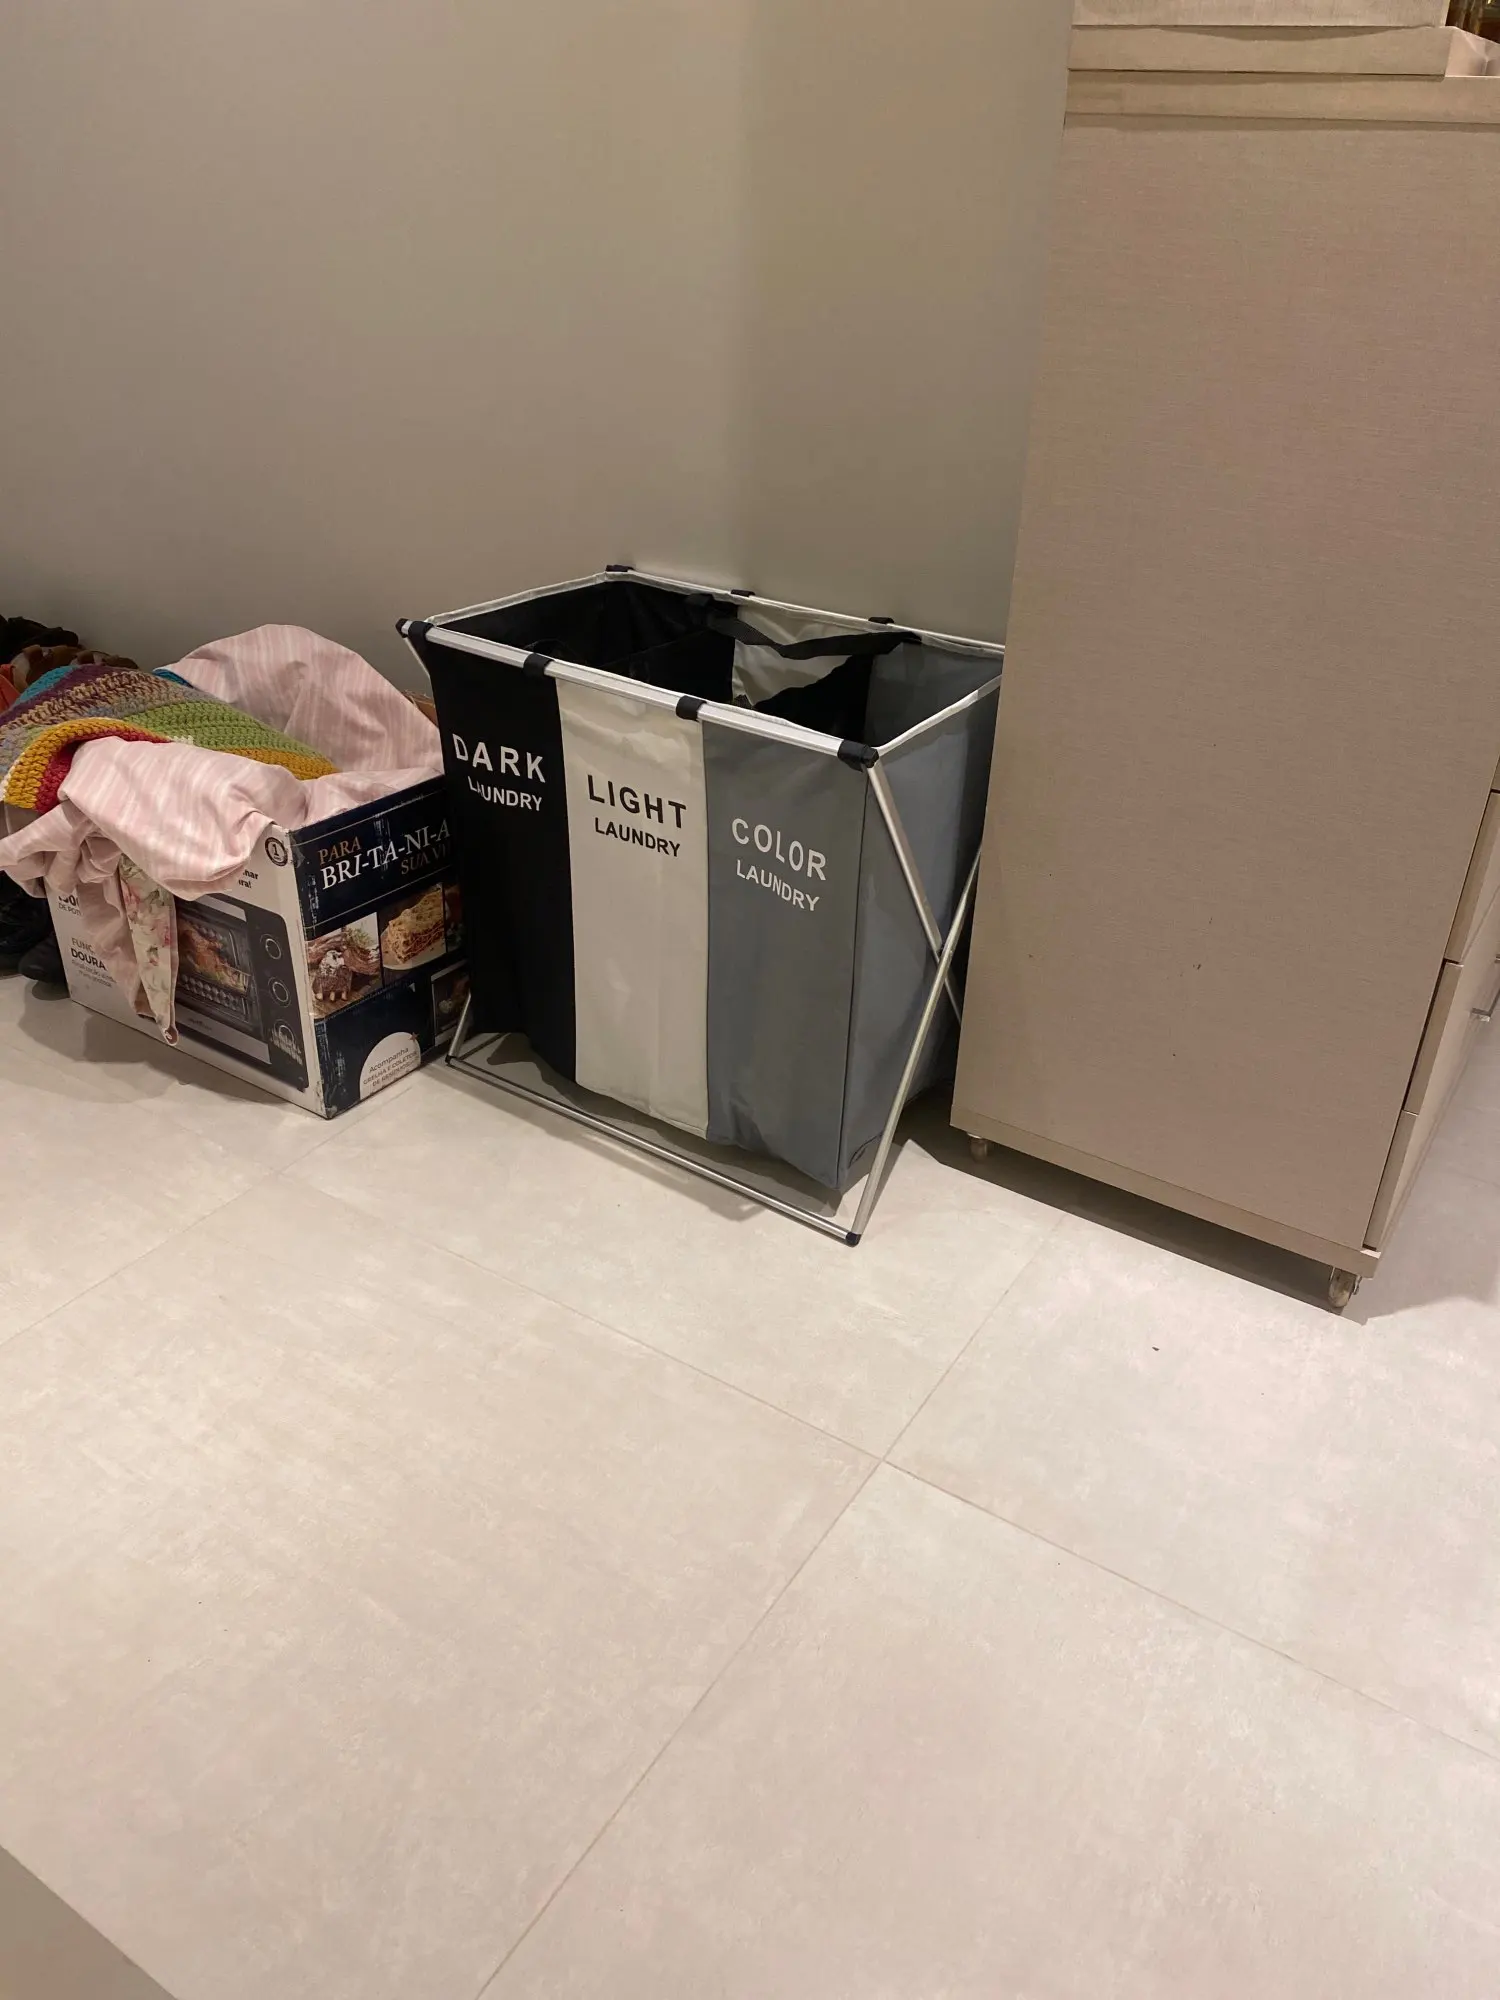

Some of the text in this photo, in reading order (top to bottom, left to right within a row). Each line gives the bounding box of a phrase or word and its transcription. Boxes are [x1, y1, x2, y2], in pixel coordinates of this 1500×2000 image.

[452, 733, 546, 783] DARK
[587, 774, 687, 829] LIGHT
[318, 836, 362, 865] PARA
[320, 818, 450, 890] BRI-TA-NI-A
[594, 817, 681, 857] LAUNDRY
[731, 818, 827, 881] COLOR
[401, 853, 431, 875] SUA
[736, 859, 820, 912] LAUNDRY
[70, 947, 107, 972] DOURA
[363, 1068, 387, 1085] GRELHA
[369, 1047, 409, 1073] Acompanha
